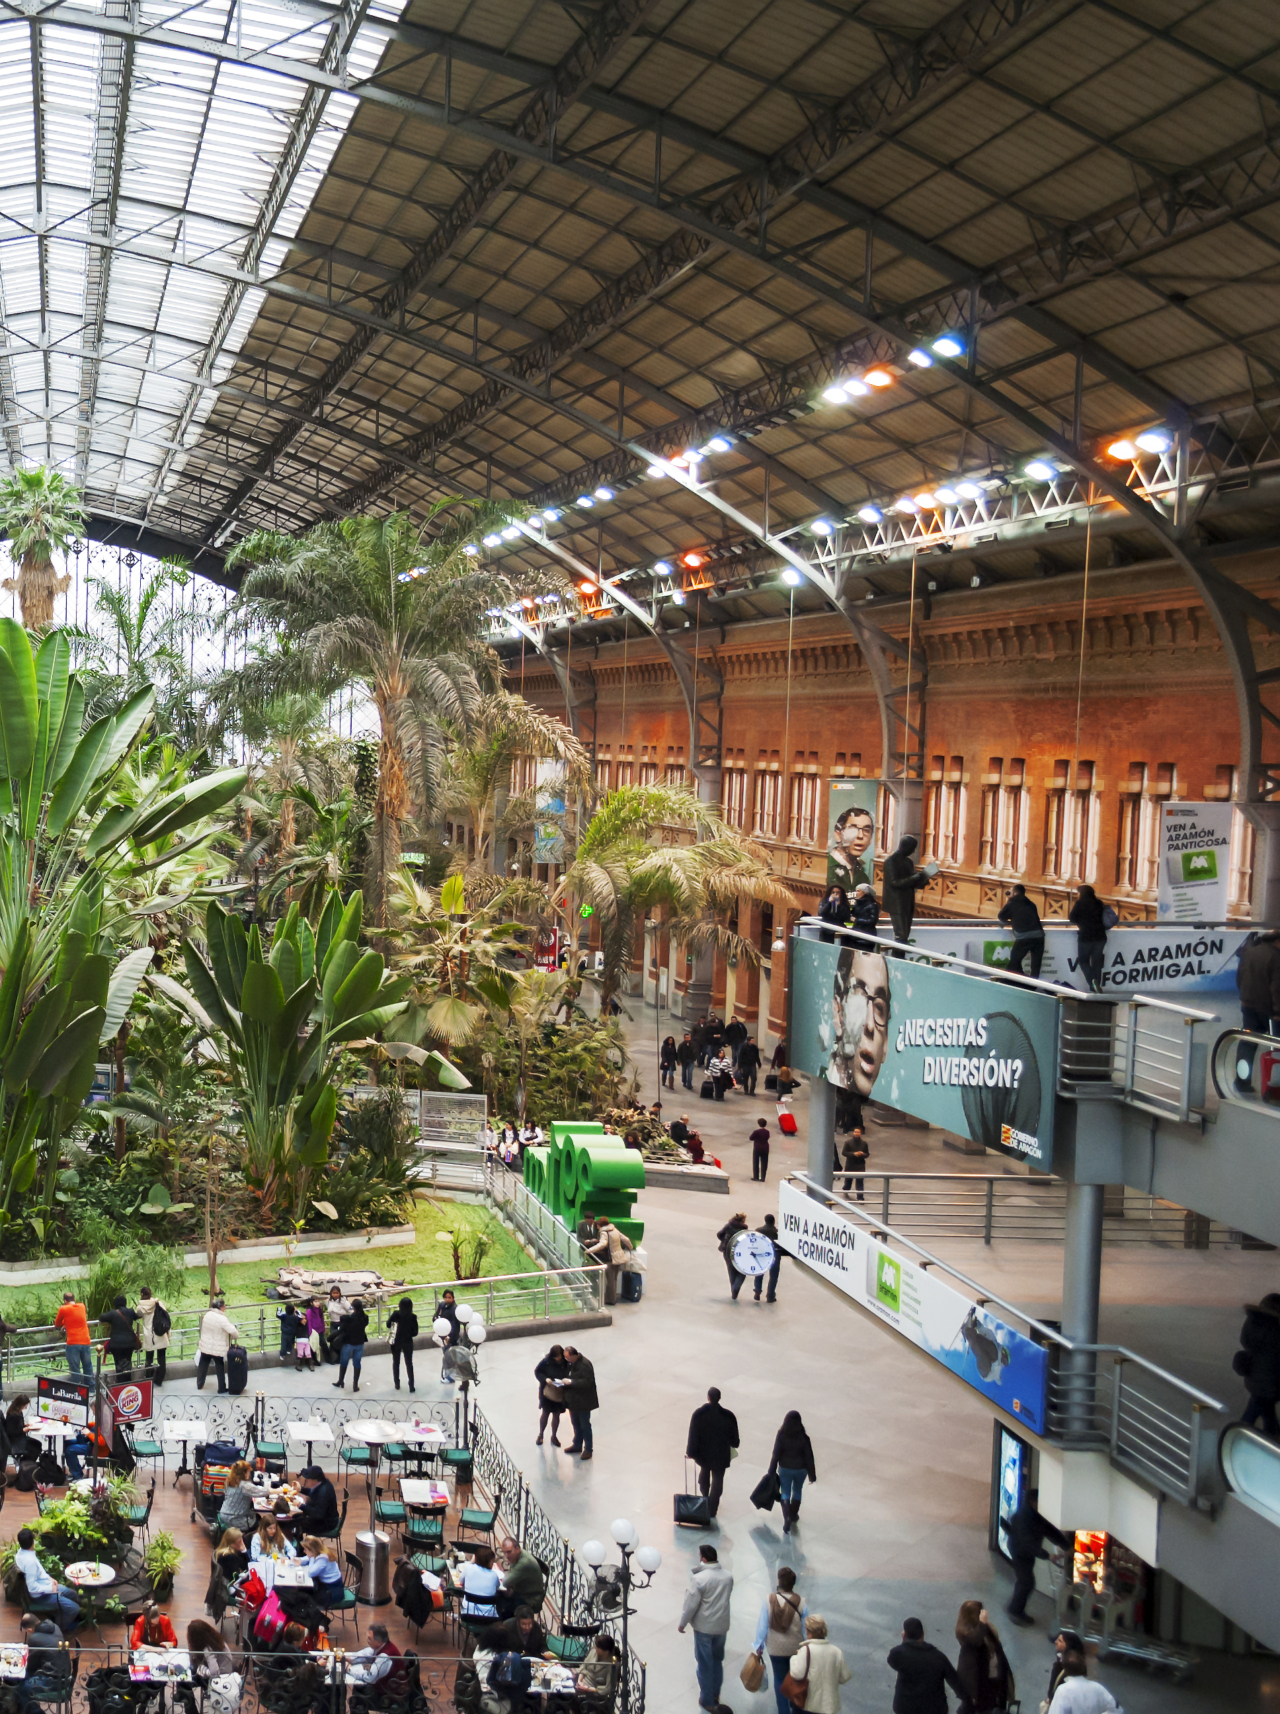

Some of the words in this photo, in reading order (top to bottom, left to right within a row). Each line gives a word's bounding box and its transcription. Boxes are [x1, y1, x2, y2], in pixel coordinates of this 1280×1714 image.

[1166, 823, 1187, 833] VEN
[1189, 822, 1197, 830] A
[1166, 828, 1215, 843] ARAMÓN
[1167, 837, 1230, 852] PANTICOSA.
[1111, 951, 1125, 967] A
[1131, 936, 1224, 965] ARAMÓN
[1101, 960, 1211, 987] FORMIGAL.
[896, 1017, 988, 1052] ¿NECESITAS
[923, 1048, 1023, 1089] DIVERSIÓN?
[783, 1212, 800, 1233] VEN
[802, 1218, 809, 1236] A
[811, 1225, 855, 1250] ARAMÓN
[798, 1238, 849, 1272] FORMIGAL.
[121, 1390, 139, 1403] BURGER
[121, 1395, 139, 1410] KING
